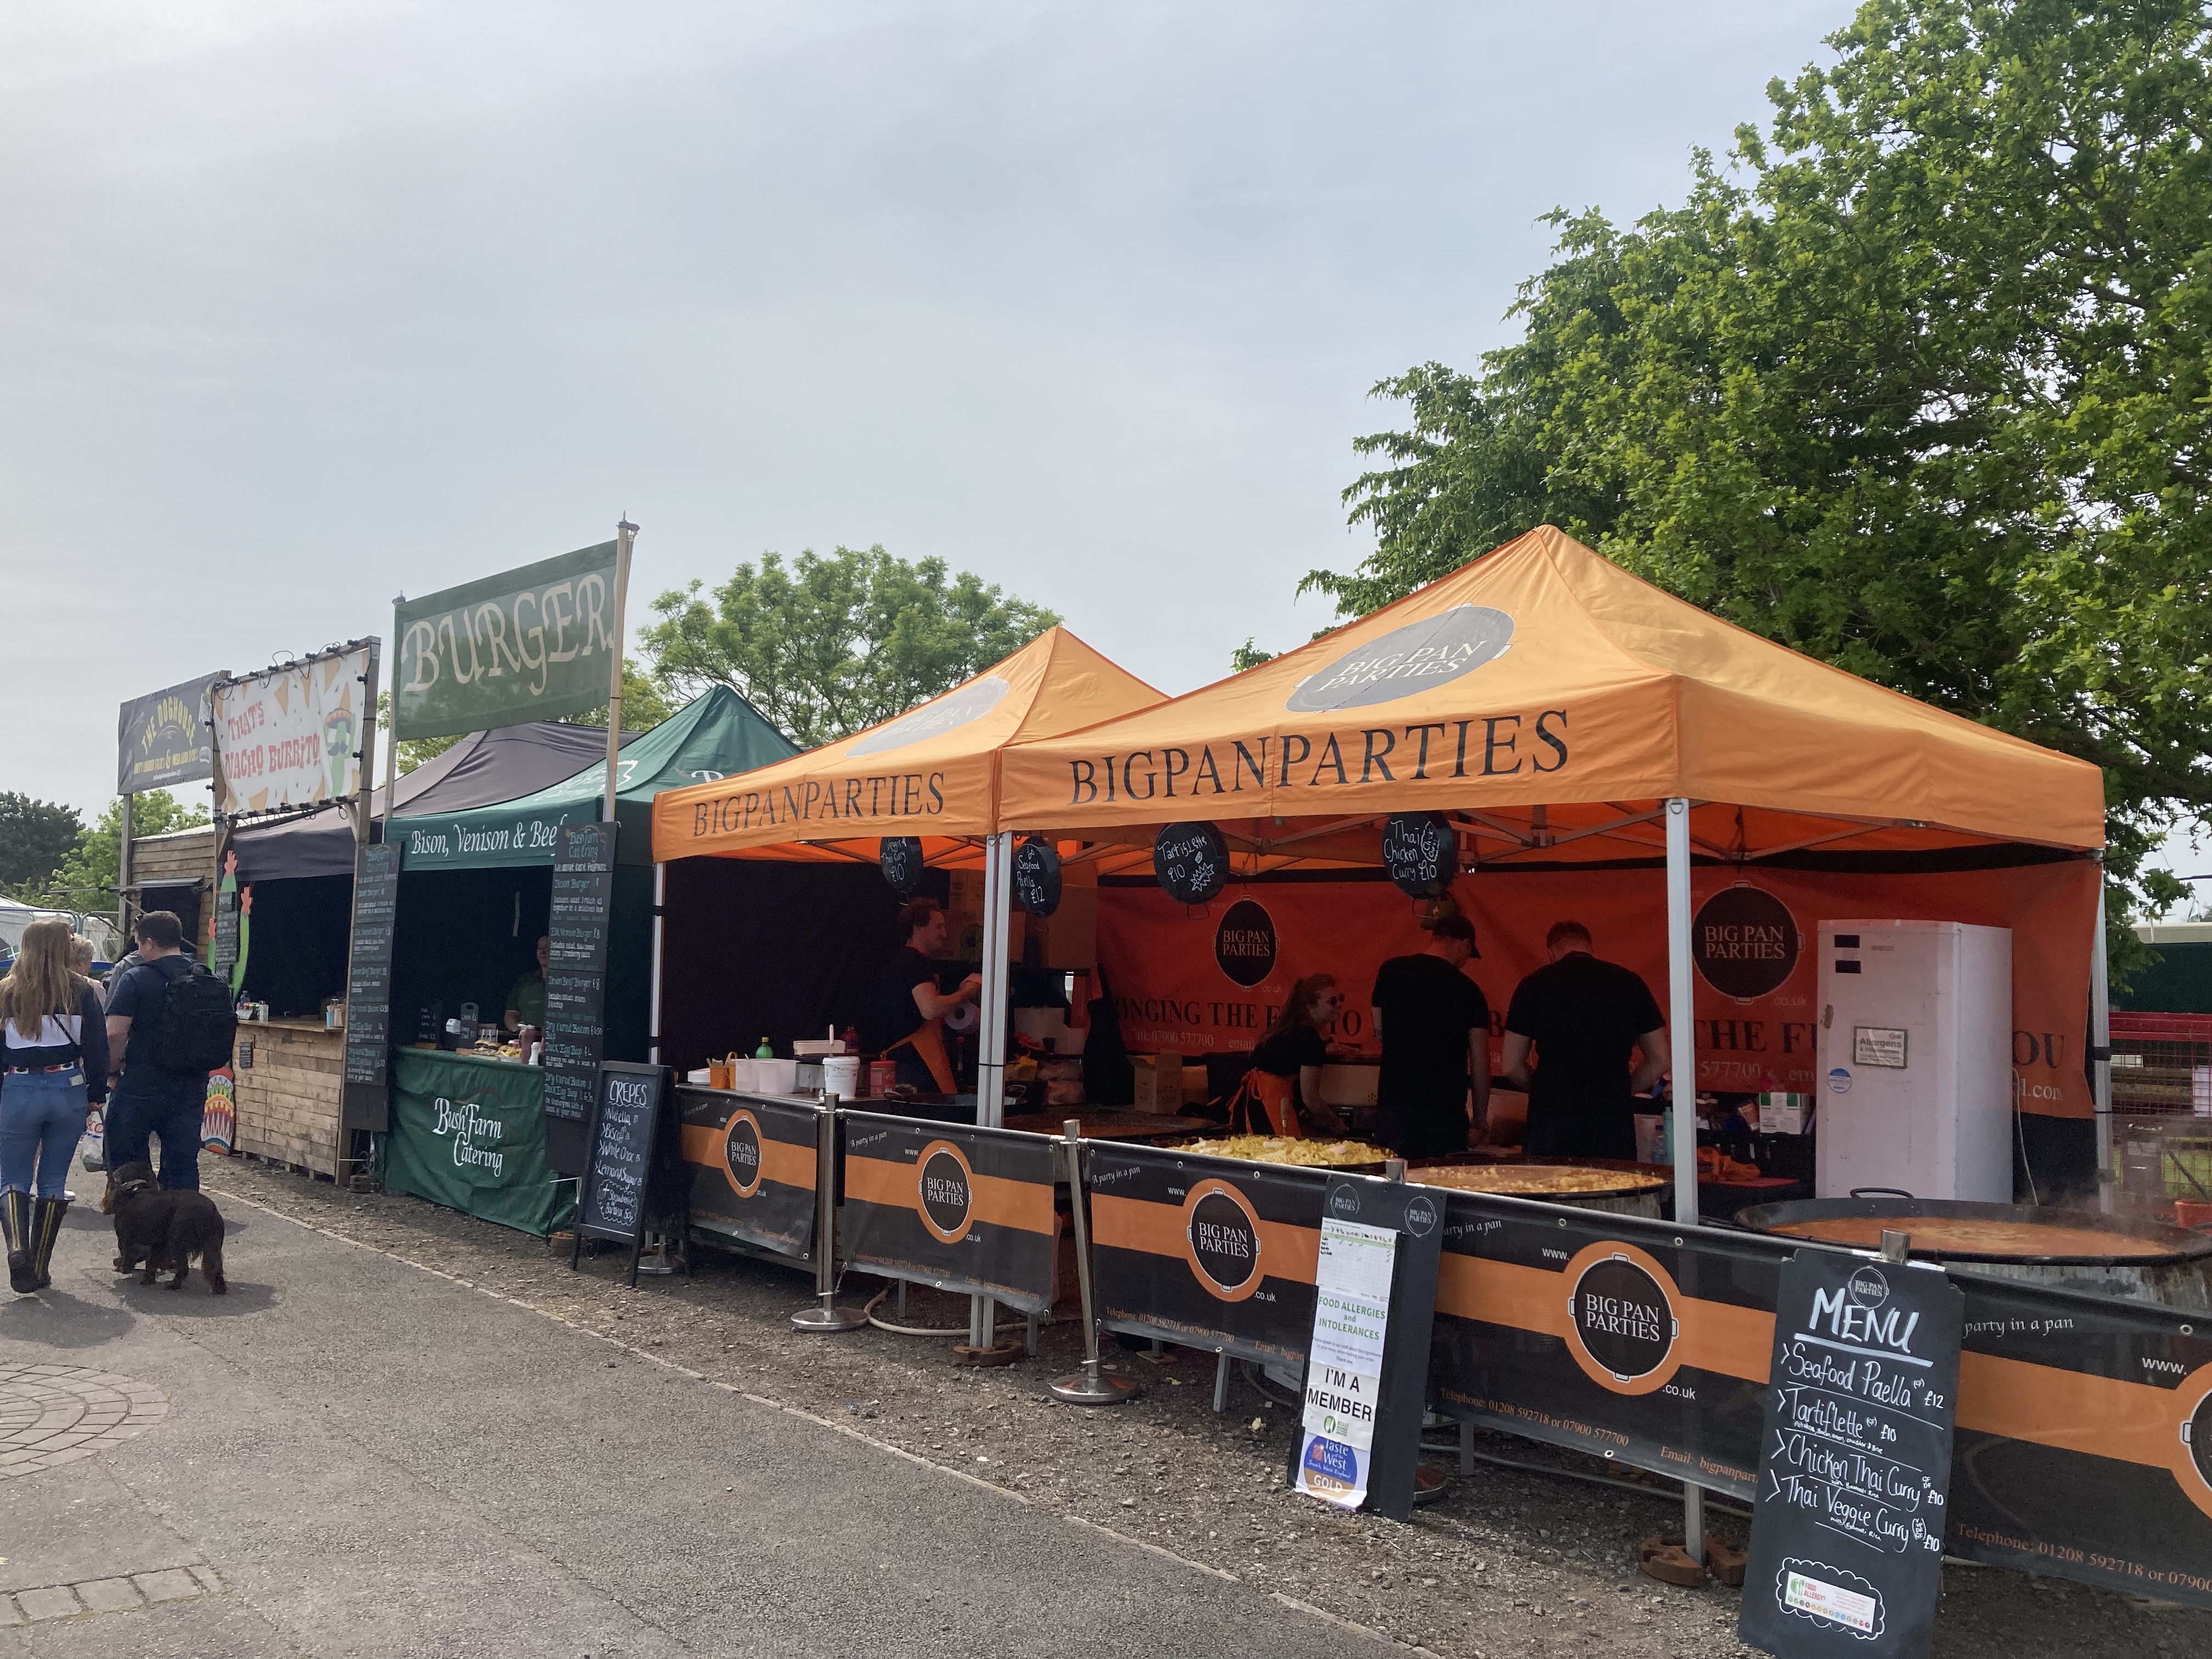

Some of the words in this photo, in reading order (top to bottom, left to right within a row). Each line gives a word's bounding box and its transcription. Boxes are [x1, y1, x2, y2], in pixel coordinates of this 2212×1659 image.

[401, 571, 617, 696] BURGER
[1338, 653, 1404, 676] BIG
[1405, 641, 1488, 663] PAN
[1317, 658, 1467, 691] PARTIES
[142, 716, 157, 756] THE
[157, 696, 196, 748] DOGHOUSE
[228, 700, 264, 741] THAT'S
[225, 744, 263, 779] NACHO
[268, 732, 321, 772] BURRITO!
[411, 829, 450, 857] Bison,
[453, 824, 509, 854] Venison
[512, 822, 527, 848] &
[1391, 820, 1419, 845] Thai
[568, 845, 598, 862] Catering
[881, 853, 893, 865] Thai
[1384, 839, 1418, 862] Chicken
[890, 864, 905, 882] £10
[1018, 855, 1040, 873] Seafood
[1167, 864, 1185, 882] £10
[1392, 864, 1416, 881] Curry
[1418, 860, 1437, 881] £10
[571, 878, 590, 893] Burger
[1017, 872, 1035, 888] Paella
[1031, 886, 1045, 904] £12
[1223, 930, 1244, 943] BIG
[1246, 930, 1269, 943] PAN
[1705, 926, 1739, 942] BIG
[1745, 926, 1784, 942] PAN
[1223, 944, 1271, 956] PARTIES
[1705, 943, 1785, 959] PARTIES
[1116, 996, 1201, 1025] INGING
[1207, 1001, 1258, 1029] THE
[1860, 1037, 1901, 1048] Allergens
[610, 1080, 647, 1106] CREPES
[606, 1107, 631, 1126] Nutella
[731, 1141, 744, 1152] BIG
[745, 1143, 757, 1155] PAN
[855, 1136, 868, 1149] party
[869, 1133, 874, 1142] in
[878, 1131, 887, 1142] pan
[454, 1131, 503, 1177] Catering
[602, 1141, 620, 1160] White
[619, 1146, 635, 1163] Choc
[731, 1151, 757, 1166] PARTIES
[927, 1177, 944, 1191] BIG
[946, 1180, 964, 1194] PAN
[1092, 1173, 1099, 1184] A
[1099, 1171, 1115, 1187] party
[1115, 1168, 1122, 1179] in
[1128, 1165, 1141, 1181] pan
[927, 1189, 964, 1206] PARTIES
[1168, 1186, 1187, 1197] www.
[1335, 1202, 1356, 1211] PARTIES
[1409, 1215, 1431, 1224] PARTIES
[1465, 1222, 1475, 1233] in
[1476, 1223, 1483, 1232] a
[1485, 1219, 1502, 1237] pan
[965, 1233, 981, 1243] .co.uk
[1199, 1222, 1221, 1239] BIG
[1223, 1227, 1247, 1244] PAN
[1200, 1237, 1249, 1259] PARTIES
[1542, 1247, 1570, 1261] www.
[1855, 1280, 1867, 1288] BIG
[1869, 1282, 1883, 1293] PAN
[1855, 1286, 1882, 1297] PARTIES
[1253, 1291, 1277, 1303] .co.uk
[1319, 1296, 1340, 1308] FOOD
[1341, 1301, 1386, 1320] ALLERGIES
[1585, 1293, 1619, 1316] BIG
[1622, 1300, 1660, 1324] PAN
[1344, 1313, 1356, 1323] and
[1585, 1311, 1660, 1342] PARTIES
[1809, 1287, 1920, 1353] MENU
[1962, 1318, 2006, 1339] party
[2011, 1318, 2027, 1330] in
[2030, 1319, 2040, 1330] a
[2042, 1316, 2074, 1336] pan
[1106, 1306, 1138, 1322] Telephone:
[1138, 1312, 1158, 1325] 01208
[1158, 1318, 1181, 1331] 592718
[1189, 1325, 1210, 1338] 07900
[1210, 1329, 1235, 1344] 577700
[1255, 1340, 1277, 1355] Email:
[1280, 1346, 1305, 1362] bigpan
[1319, 1318, 1379, 1340] INTOLERANCES
[1789, 1342, 1857, 1391] Seafood
[1861, 1361, 1911, 1408] Paella
[1924, 1390, 1944, 1409] £12
[2142, 1357, 2187, 1375] www.
[1325, 1368, 1344, 1388] I'M
[1350, 1376, 1360, 1393] A
[1662, 1384, 1696, 1401] .co.uk
[1307, 1388, 1372, 1422] MEMBER
[1785, 1386, 1863, 1439] Tartiflette
[1881, 1429, 1897, 1442] £10
[1441, 1387, 1486, 1409] Telephone:
[1489, 1400, 1515, 1414] 01208
[1517, 1407, 1550, 1425] 592718
[1551, 1419, 1561, 1427] or
[1564, 1419, 1591, 1436] 07900
[1593, 1428, 1629, 1446] 577700
[1660, 1446, 1693, 1465] Email:
[1700, 1457, 1759, 1483] bigpanpart
[1325, 1439, 1348, 1456] Taste
[1323, 1451, 1346, 1471] West
[1787, 1434, 1848, 1481] Chicken
[1849, 1454, 1883, 1492] Thai
[1887, 1466, 1920, 1513] Curry
[1927, 1488, 1944, 1506] £10
[1313, 1474, 1343, 1493] GOLD
[1781, 1474, 1819, 1509] Thai
[1826, 1486, 1871, 1527] Veggie
[1875, 1507, 1909, 1554] Curry
[1923, 1534, 1939, 1552] £10
[1959, 1523, 2033, 1553] Telephone:
[2038, 1542, 2084, 1563] 01208
[2088, 1553, 2145, 1577] 592718
[2148, 1570, 2165, 1582] or
[1804, 1590, 1826, 1602] ALLERGY?
[1805, 1582, 1816, 1591] FOOD
